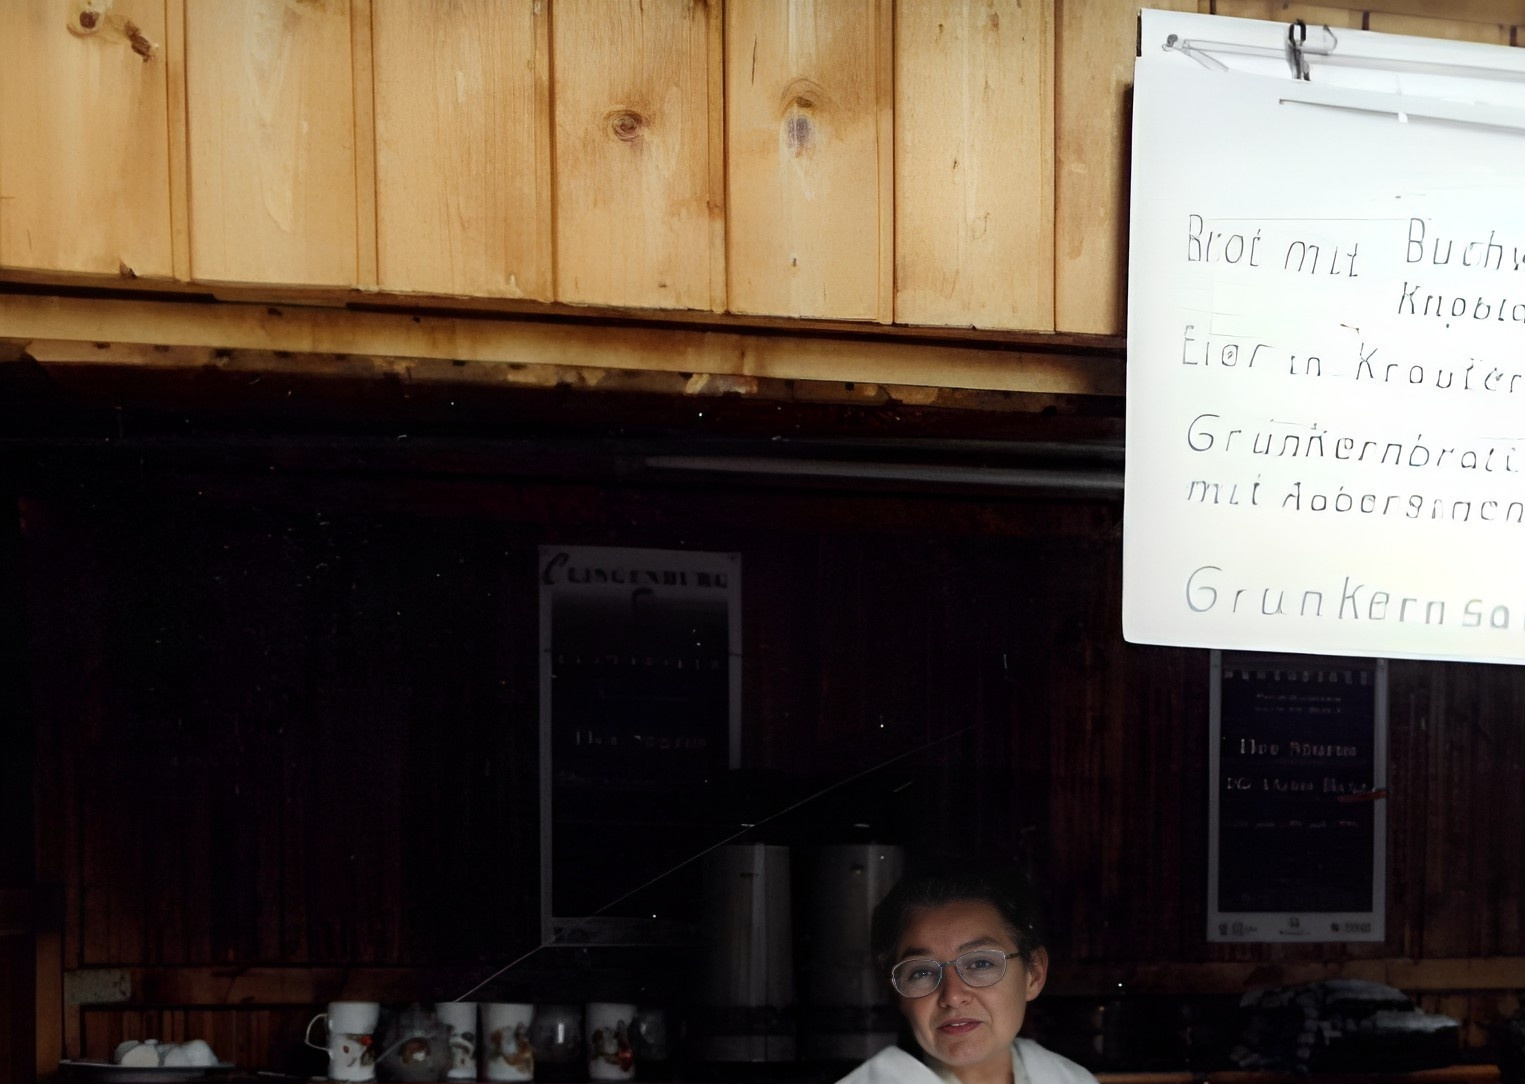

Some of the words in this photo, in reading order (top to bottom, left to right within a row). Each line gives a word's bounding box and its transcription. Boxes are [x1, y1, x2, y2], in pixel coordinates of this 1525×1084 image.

[1187, 213, 1262, 268] Brot
[1284, 239, 1359, 278] mit
[1289, 354, 1321, 377] in
[1186, 473, 1262, 506] mit
